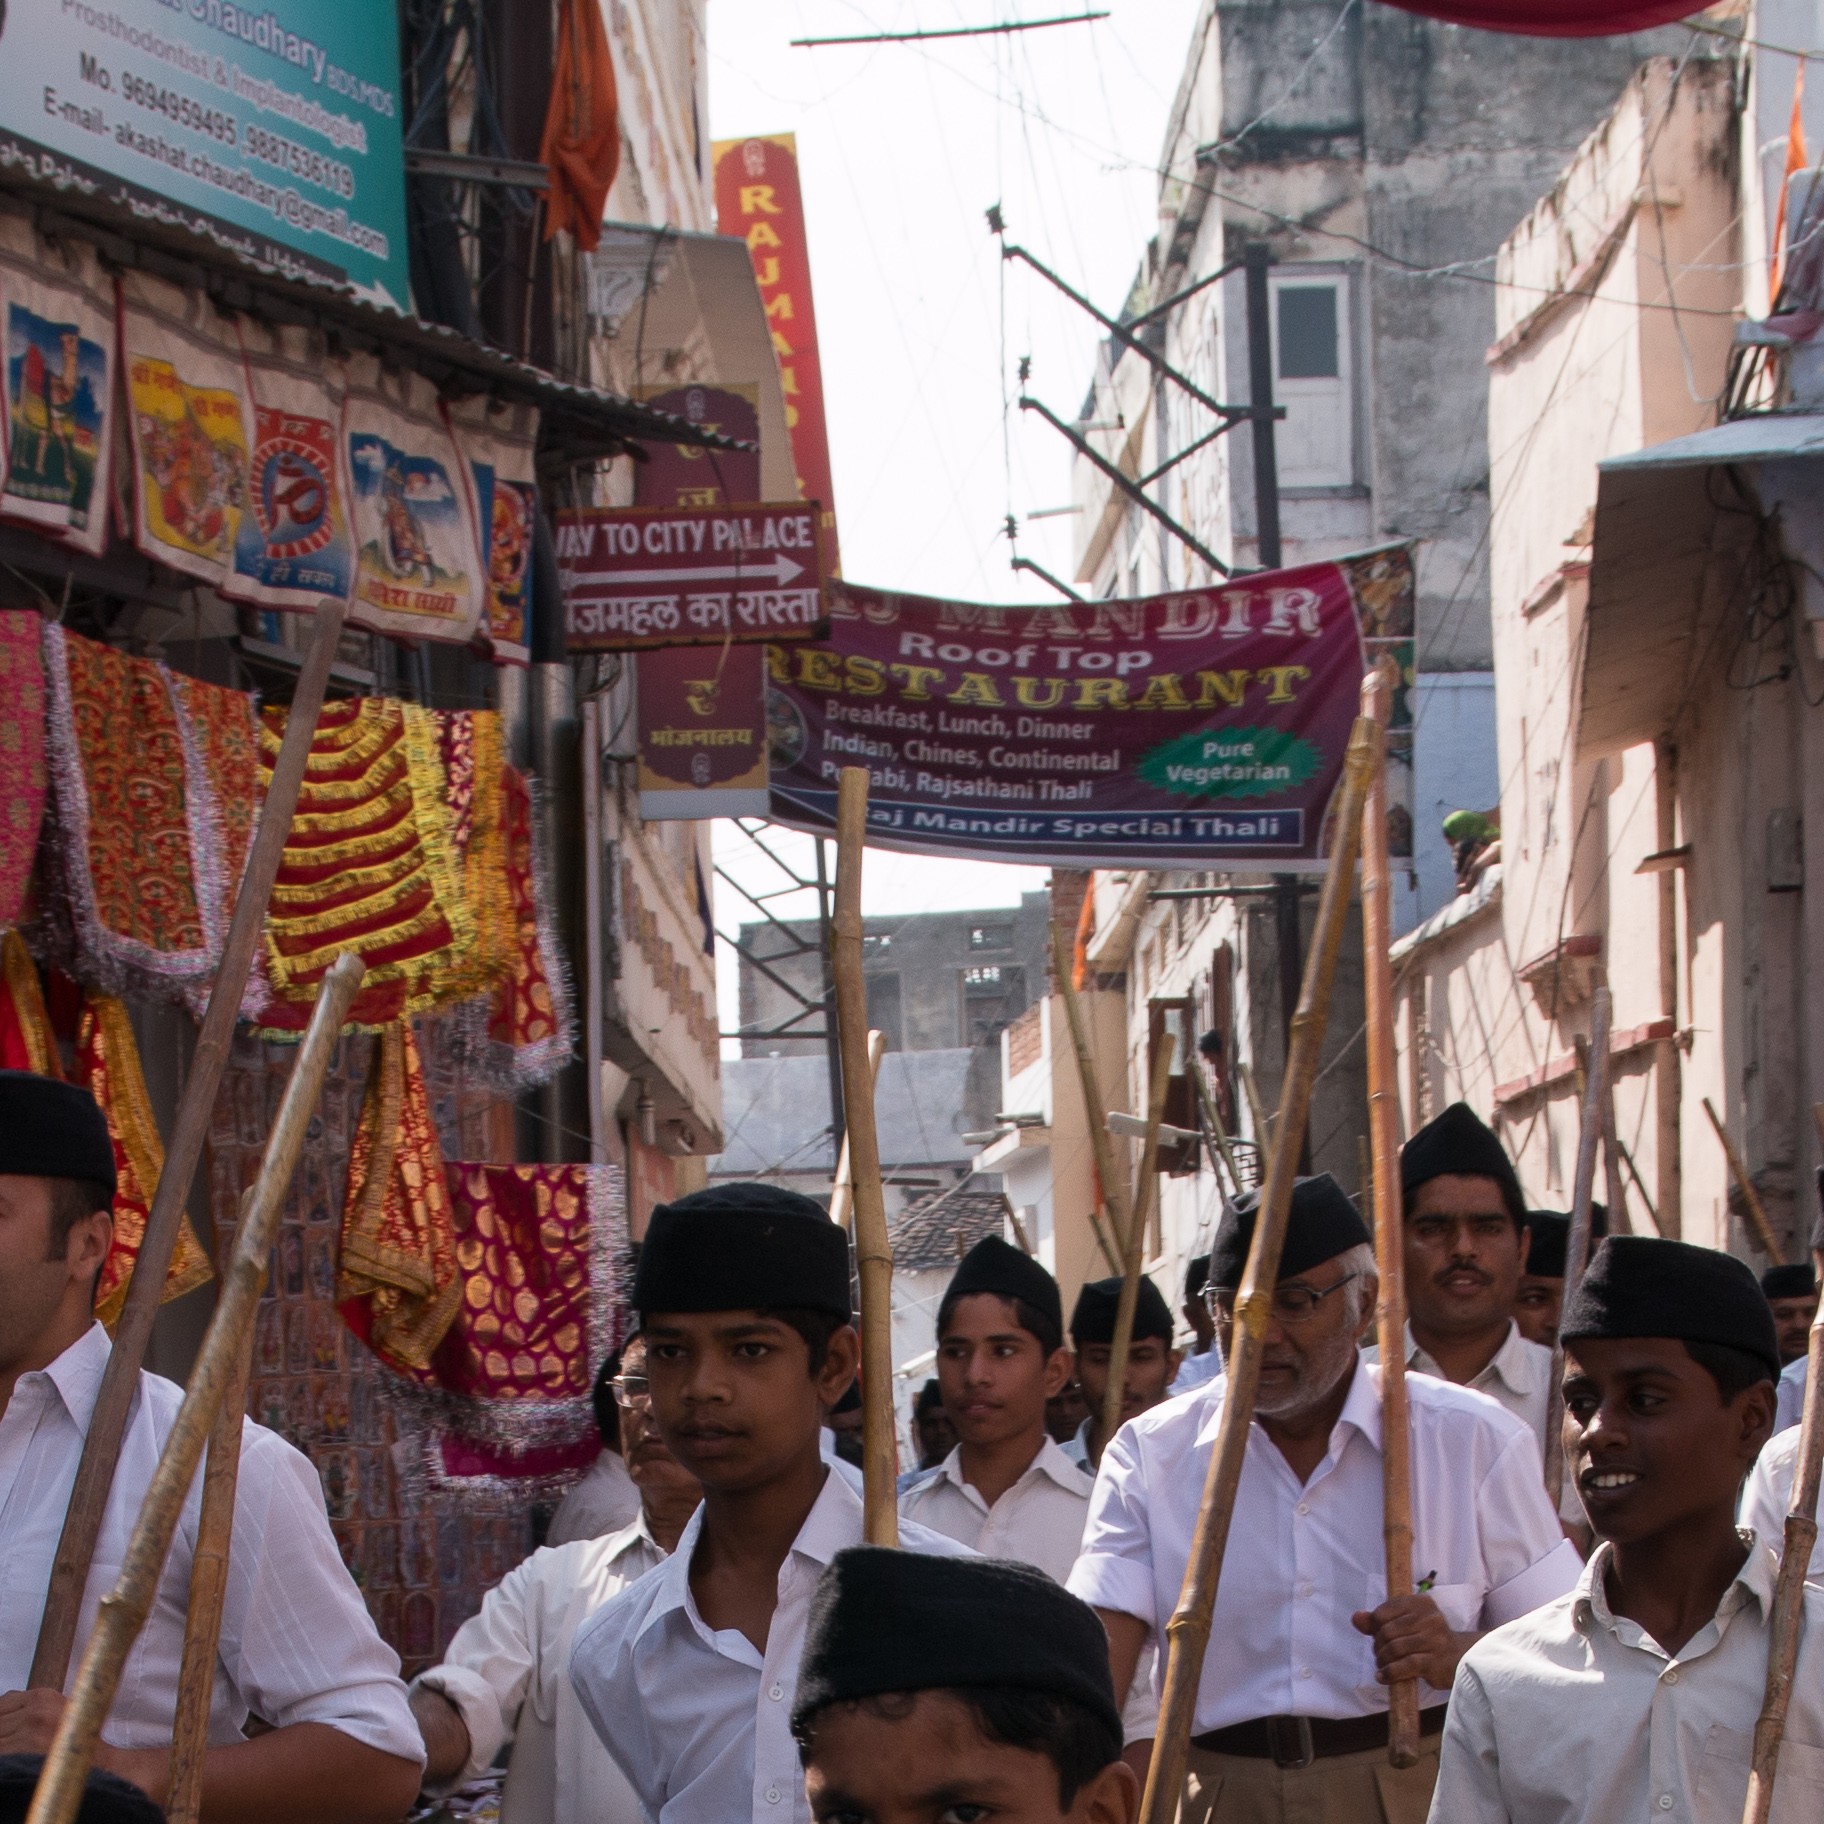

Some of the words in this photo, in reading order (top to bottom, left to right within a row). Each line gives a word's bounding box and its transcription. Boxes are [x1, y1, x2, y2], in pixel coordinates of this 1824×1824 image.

[80, 51, 117, 94] Mo.
[122, 71, 237, 146] 9694959495
[232, 65, 368, 154] Implantologist
[601, 522, 641, 555] TO
[643, 520, 707, 554] CITY
[711, 514, 815, 551] PALACE
[561, 595, 680, 636] ाजमहल
[686, 592, 732, 627] का
[736, 587, 820, 625] रास्ता
[936, 587, 1322, 641] MANDIR
[898, 631, 1037, 669] Roof
[1047, 646, 1154, 676] Top
[767, 643, 1312, 711] RESTAURANT
[650, 724, 754, 746] भोजनालय
[825, 699, 933, 734] Breakfast,
[938, 711, 1012, 739] Lunch,
[1017, 716, 1095, 741] Dinner
[822, 729, 900, 762] Indian,
[903, 739, 984, 769] Chines,
[988, 746, 1121, 772] Continental
[1202, 741, 1254, 759] Pure
[916, 771, 1035, 800] Rajsathani
[1038, 779, 1094, 800] Thali
[1165, 762, 1291, 786] Vegetarian
[866, 806, 904, 827] aj
[912, 811, 1045, 835] Mandir
[1052, 818, 1184, 838] Special
[1187, 818, 1281, 836] Thali
